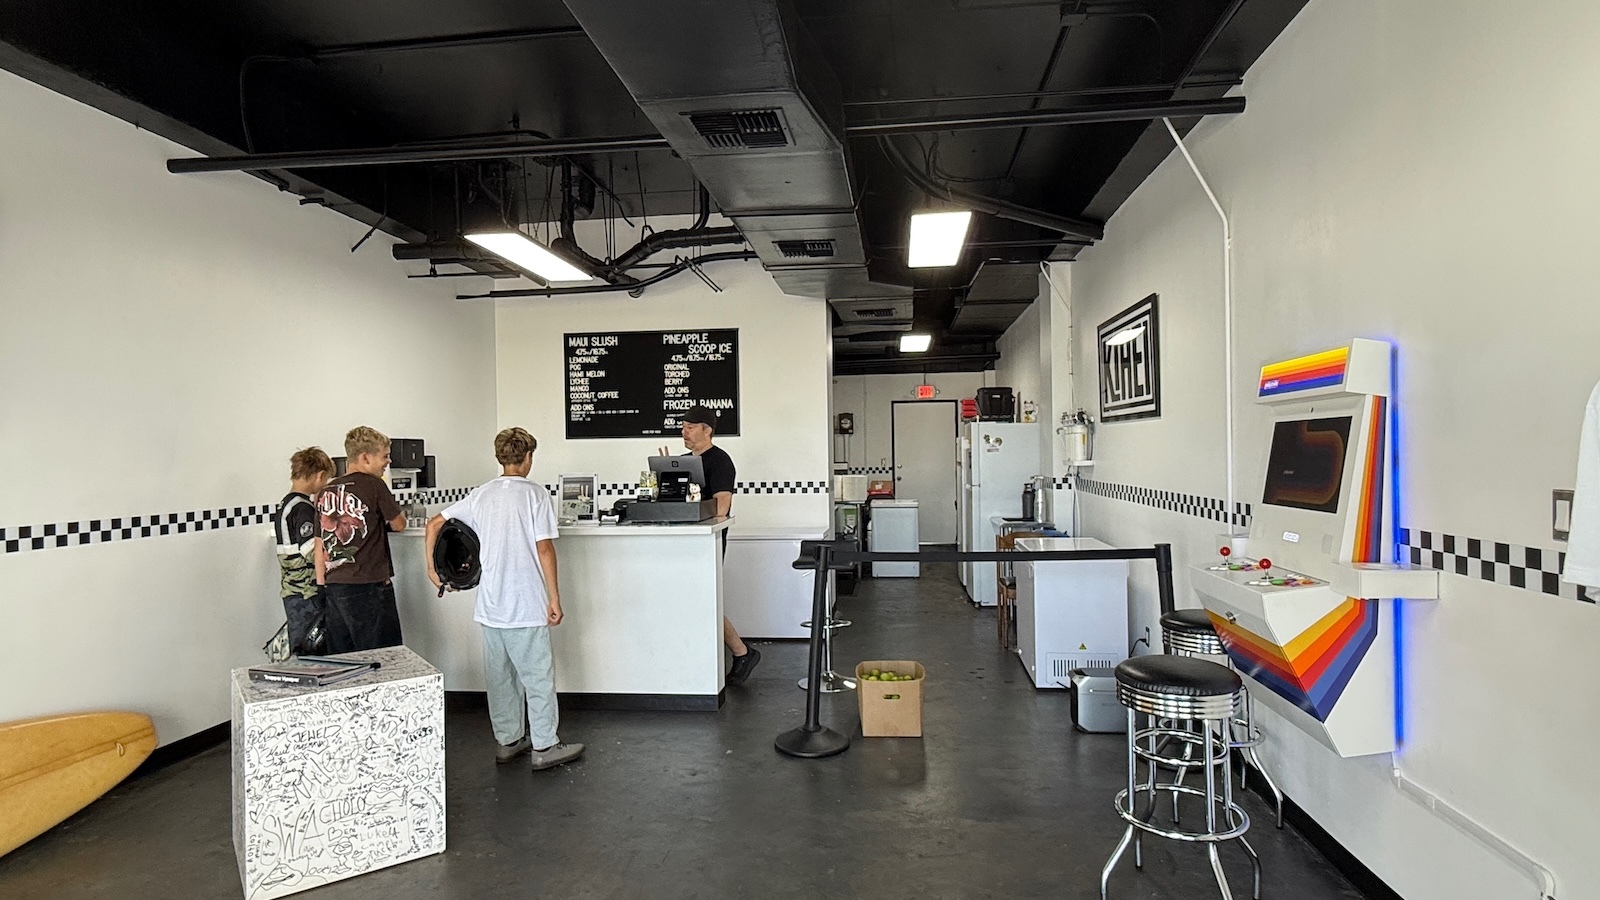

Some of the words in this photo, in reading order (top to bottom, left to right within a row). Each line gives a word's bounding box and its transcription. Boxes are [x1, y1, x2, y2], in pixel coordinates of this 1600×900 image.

[569, 337, 588, 347] MAUI
[591, 336, 618, 347] SLUSH
[663, 333, 709, 344] PINEAPPLE
[688, 344, 717, 354] SCOOP
[719, 343, 733, 353] ICE
[569, 356, 599, 364] LEMONADE
[664, 363, 690, 371] ORIGINAL
[586, 370, 605, 378] MELON
[677, 386, 690, 394] ONS
[570, 392, 596, 400] COCONUT
[597, 391, 619, 399] COFFEE
[663, 400, 696, 410] FROZEN
[663, 418, 676, 426] ADD
